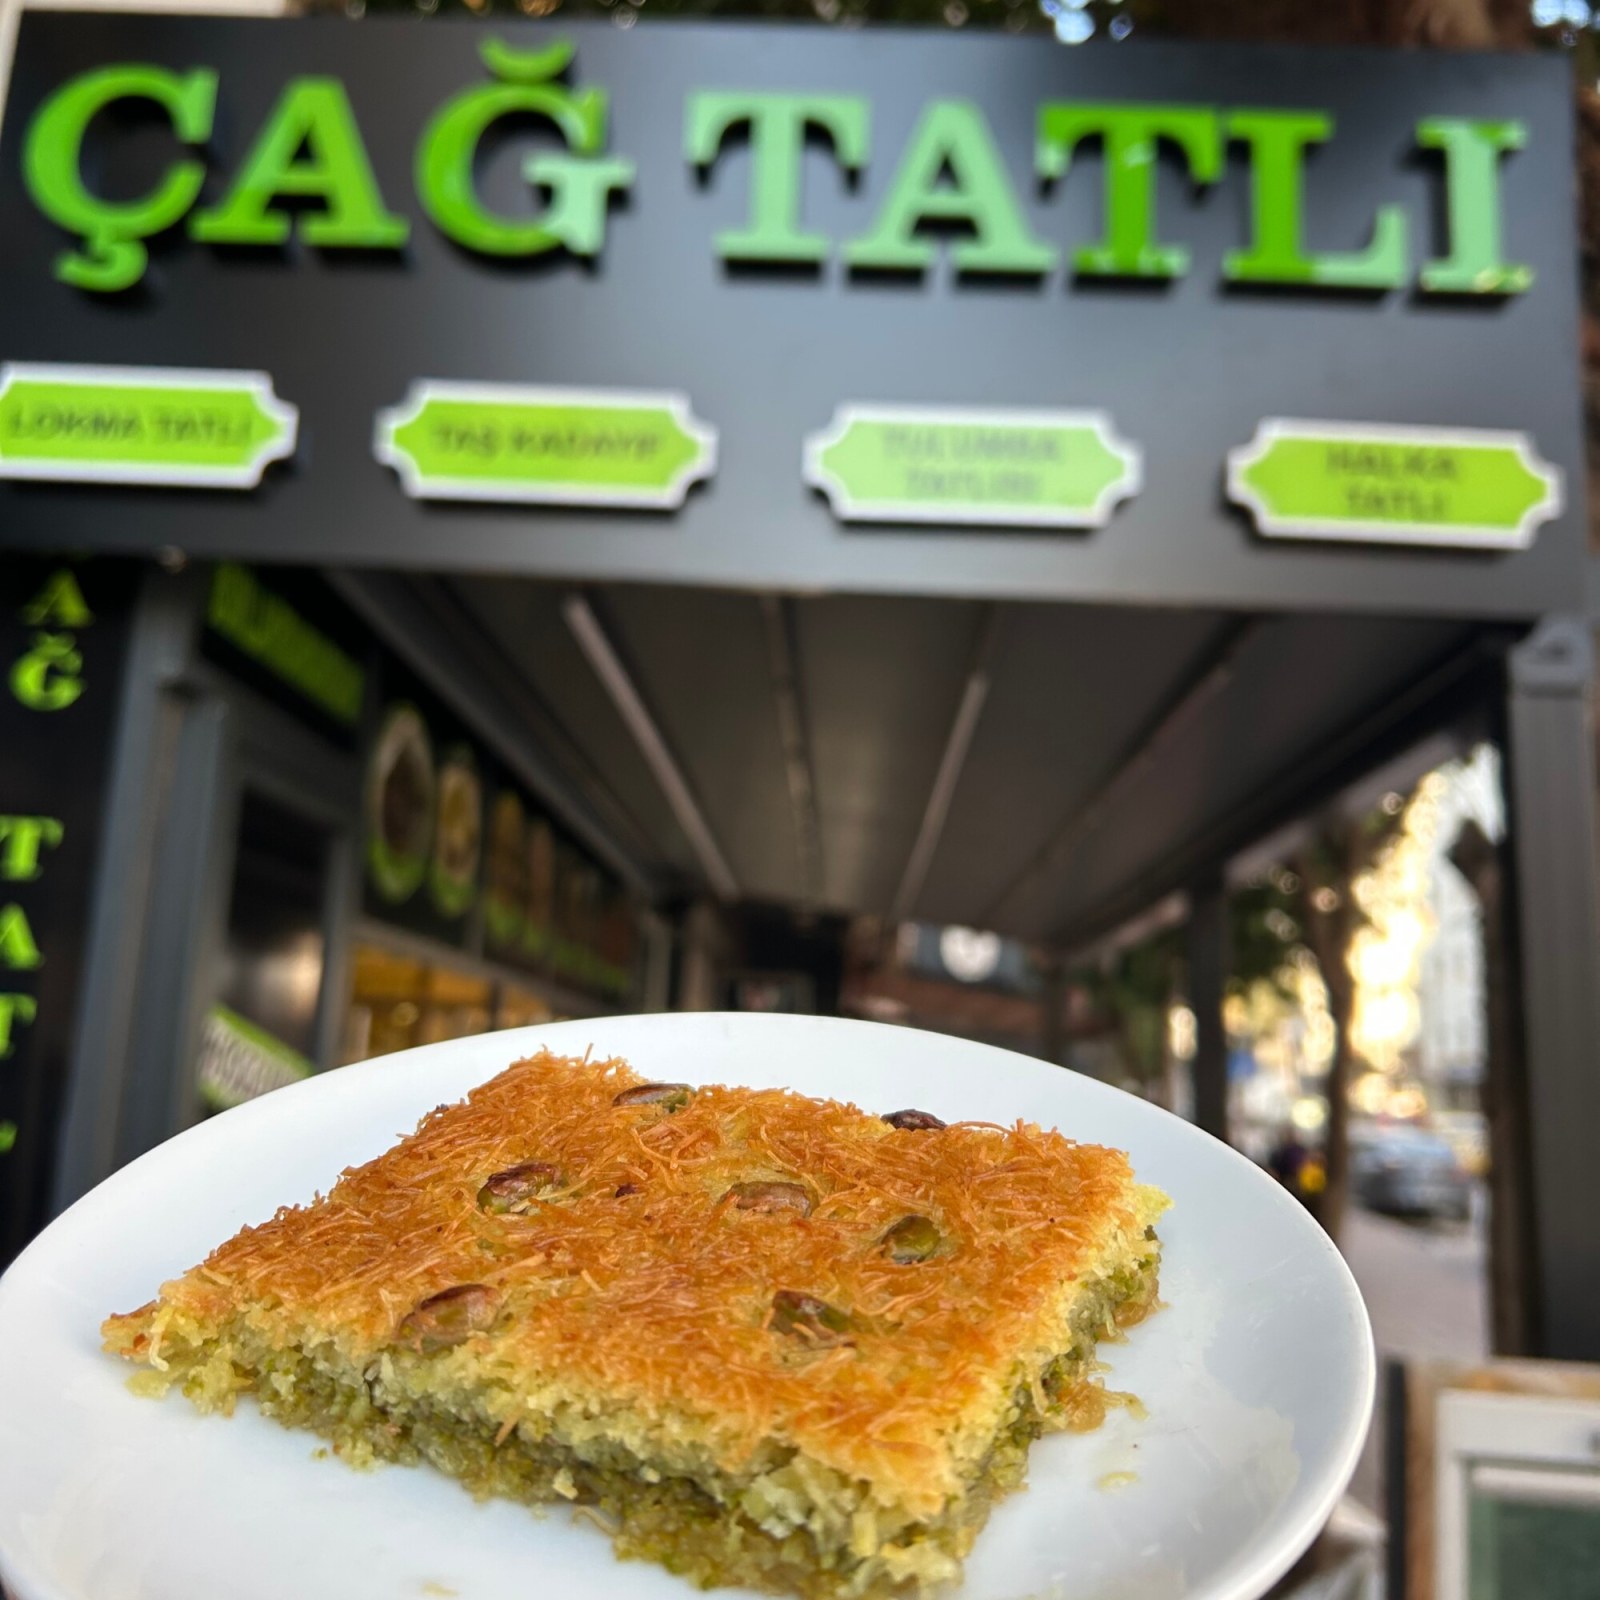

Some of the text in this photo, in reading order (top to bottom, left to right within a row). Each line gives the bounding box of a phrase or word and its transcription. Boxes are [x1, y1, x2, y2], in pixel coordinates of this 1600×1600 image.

[22, 38, 1534, 294] ÇAĞ TATLI
[8, 566, 96, 712] AĞ
